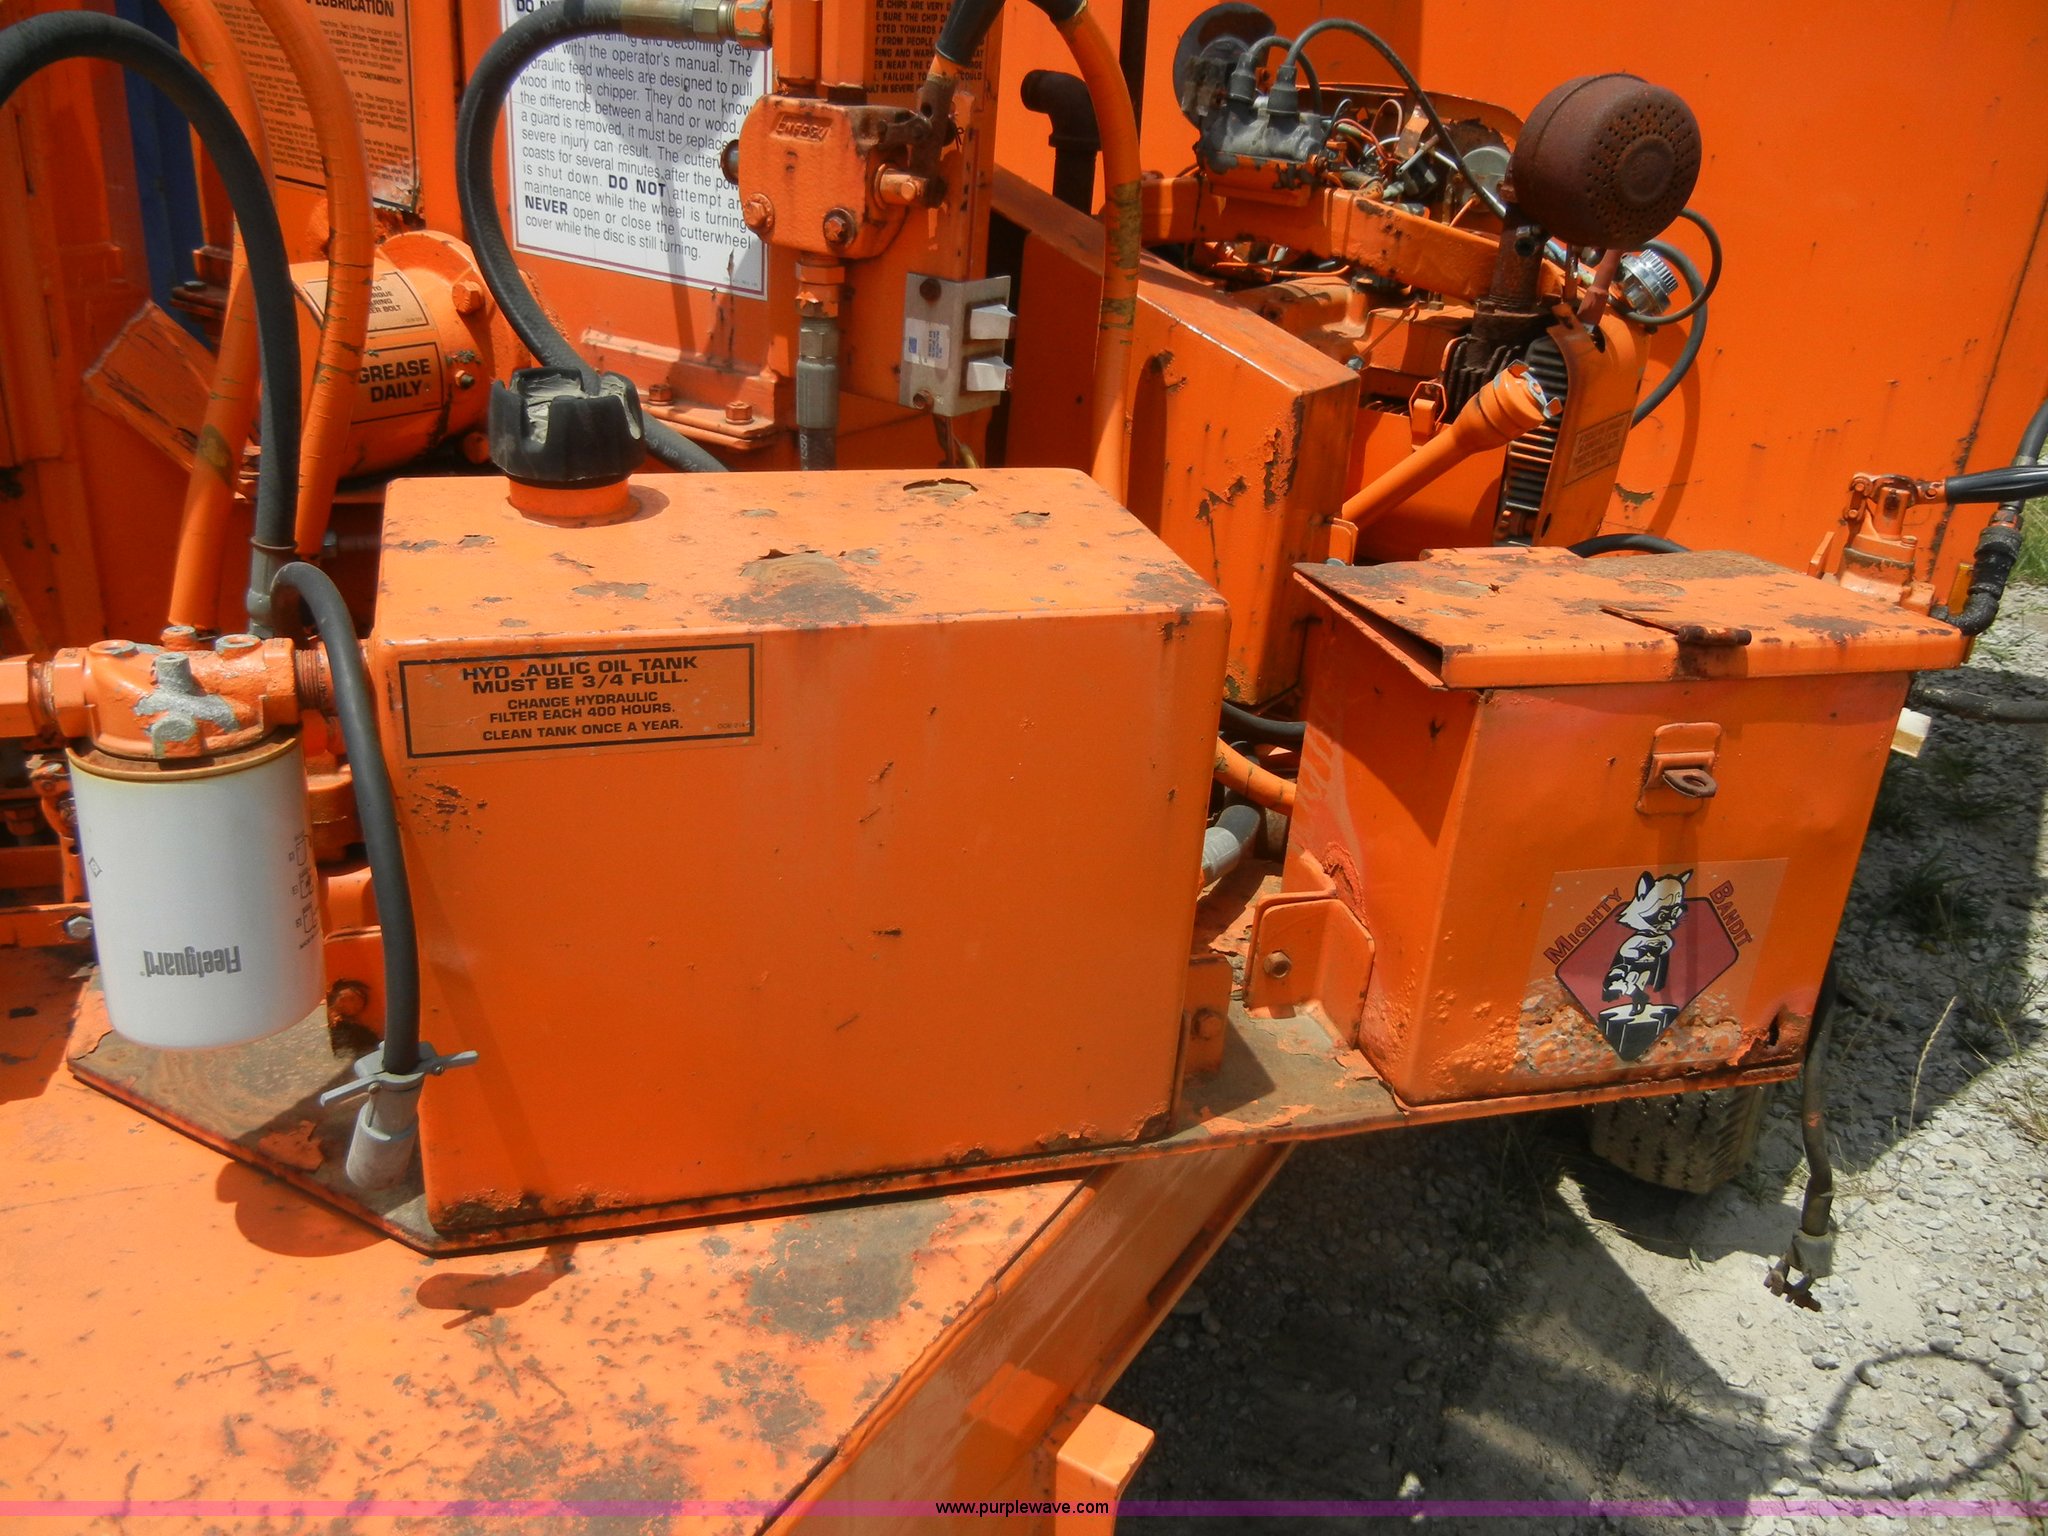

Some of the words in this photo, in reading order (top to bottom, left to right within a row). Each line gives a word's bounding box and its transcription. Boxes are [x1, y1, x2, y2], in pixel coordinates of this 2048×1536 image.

[526, 58, 566, 73] draulic
[569, 61, 592, 77] feed
[596, 64, 634, 81] wheels
[638, 71, 656, 84] are
[660, 72, 712, 92] designed
[717, 81, 728, 94] to
[732, 82, 753, 98] pull
[562, 42, 585, 57] with
[589, 44, 607, 59] the
[612, 48, 670, 67] operator's
[675, 57, 723, 73] manual.
[730, 59, 753, 77] The
[520, 75, 547, 88] wood
[551, 78, 571, 92] into
[575, 80, 592, 95] the
[597, 83, 640, 101] chipper.
[645, 88, 673, 108] They
[678, 94, 693, 108] do
[698, 98, 716, 112] not
[722, 99, 752, 115] know
[520, 92, 536, 105] the
[540, 94, 591, 113] difference
[595, 99, 640, 119] between
[645, 110, 652, 121] a
[657, 109, 684, 126] hand
[689, 116, 700, 128] or
[705, 119, 740, 134] wood.
[521, 111, 528, 121] a
[530, 112, 560, 127] guard
[563, 114, 572, 129] is
[575, 119, 624, 138] removed,
[628, 124, 635, 137] it
[638, 127, 665, 143] must
[669, 129, 682, 144] be
[686, 134, 729, 151] replace
[522, 128, 556, 144] severe
[561, 133, 589, 151] injury
[594, 140, 613, 152] can
[618, 144, 651, 159] result.
[657, 146, 678, 163] The
[684, 153, 722, 169] cutterw
[522, 146, 555, 161] coasts
[558, 149, 572, 163] for
[576, 154, 614, 171] several
[664, 167, 690, 182] after
[694, 171, 711, 187] the
[716, 177, 739, 192] pow
[523, 161, 533, 175] is
[538, 164, 562, 180] shut
[567, 169, 602, 187] down.
[608, 174, 628, 190] DO
[636, 178, 666, 198] NOT
[672, 188, 721, 208] attempt
[728, 199, 741, 211] an
[524, 180, 591, 202] maintenance
[596, 193, 624, 208] while
[629, 197, 646, 212] the
[652, 202, 685, 219] wheel
[690, 209, 700, 222] is
[525, 195, 568, 215] NEVER
[573, 207, 600, 222] open
[605, 213, 616, 224] or
[621, 214, 651, 231] close
[657, 220, 675, 236] the
[681, 226, 751, 249] cutterwheel
[526, 215, 552, 229] cover
[555, 220, 581, 235] while
[584, 225, 600, 239] the
[603, 228, 625, 244] disc
[627, 231, 636, 247] is
[639, 235, 657, 250] still
[660, 240, 701, 261] turning.
[359, 358, 431, 384] GREASE
[371, 380, 423, 403] DAILY
[472, 678, 538, 695] MUST
[546, 676, 574, 690] BE
[582, 673, 624, 689] 3/4
[632, 671, 688, 685] FULL.
[598, 660, 632, 673] OIL
[639, 656, 698, 671] TANK
[490, 711, 538, 723] FILTER
[543, 708, 582, 720] EACH
[587, 706, 616, 717] 400
[621, 703, 675, 715] HOURS.
[508, 696, 570, 710] CHANGE
[575, 691, 658, 706] HYDRAULIC
[483, 728, 532, 741] CLEAN
[537, 725, 577, 738] TANK
[582, 723, 622, 735] ONCE
[627, 722, 637, 732] A
[642, 720, 684, 731] YEAR.
[1543, 887, 1622, 966] MIGHTY
[1709, 879, 1753, 947] BANDIT
[143, 946, 242, 977] Fleetguard
